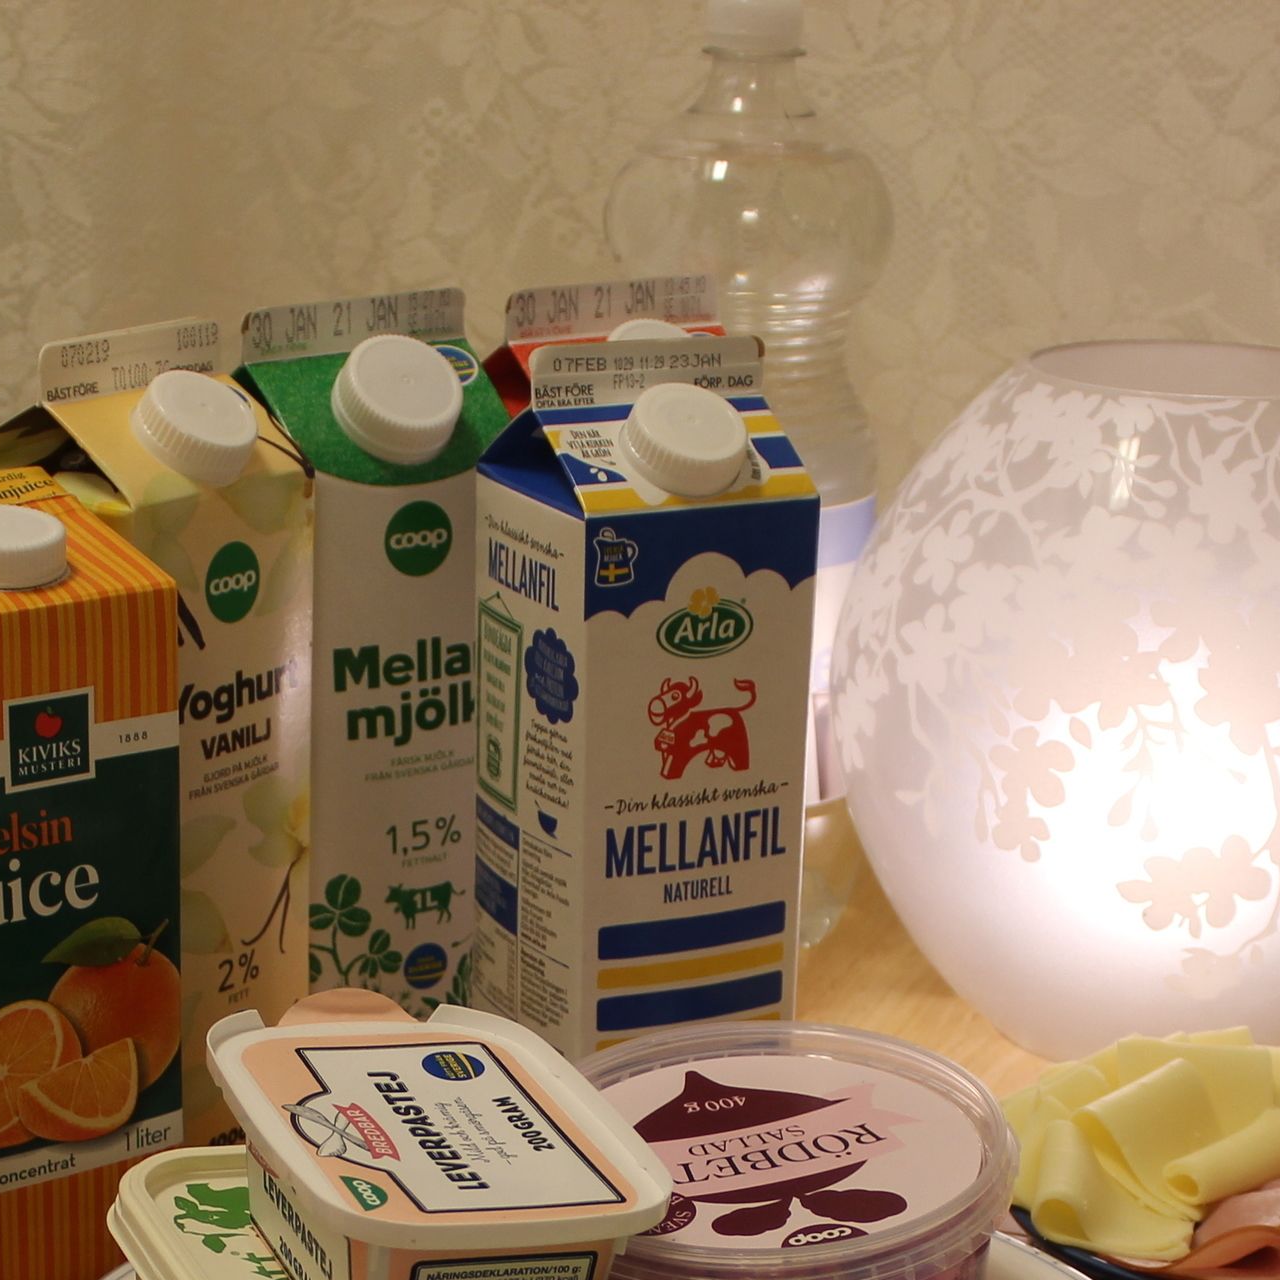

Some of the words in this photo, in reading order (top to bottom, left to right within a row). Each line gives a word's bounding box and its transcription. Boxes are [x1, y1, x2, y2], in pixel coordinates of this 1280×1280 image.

[546, 287, 579, 324] JAN
[594, 285, 611, 319] 21
[625, 280, 655, 314] JAN
[251, 312, 273, 348] 30
[285, 306, 317, 343] JAN
[333, 302, 351, 336] 21
[366, 296, 398, 331] JAN
[46, 386, 68, 402] BÄST
[70, 381, 99, 399] FÖRE
[535, 386, 563, 400] BÄST
[565, 383, 594, 398] FÖRE
[728, 374, 754, 388] DAG
[536, 400, 555, 409] OFTA
[389, 528, 448, 551] coop
[209, 569, 257, 596] coop
[488, 536, 560, 612] MELLANFIL
[673, 613, 737, 645] Arla
[178, 656, 298, 725] Yoghurt
[119, 730, 149, 743] 1888
[201, 717, 271, 760] VANILJ
[18, 739, 82, 765] KIVIKS
[18, 757, 82, 775] MUSTERI
[188, 785, 213, 800] FRÅN
[214, 773, 250, 794] SVENSKA
[651, 785, 721, 811] klassiskt
[385, 813, 462, 856] 1,5%
[605, 805, 786, 879] MELLANFIL
[663, 875, 733, 904] NATURELL
[218, 950, 259, 993] 2%
[683, 1101, 701, 1113] g
[708, 1095, 747, 1111] 400
[124, 1132, 131, 1152] 1
[135, 1126, 171, 1149] liter
[347, 1107, 394, 1156] BREDBAR
[367, 1070, 491, 1191] LEVERPASTEJ
[687, 1124, 806, 1157] SALLAD
[673, 1123, 888, 1185] RÖDBET
[350, 1179, 383, 1208] coop
[787, 1225, 852, 1247] coop
